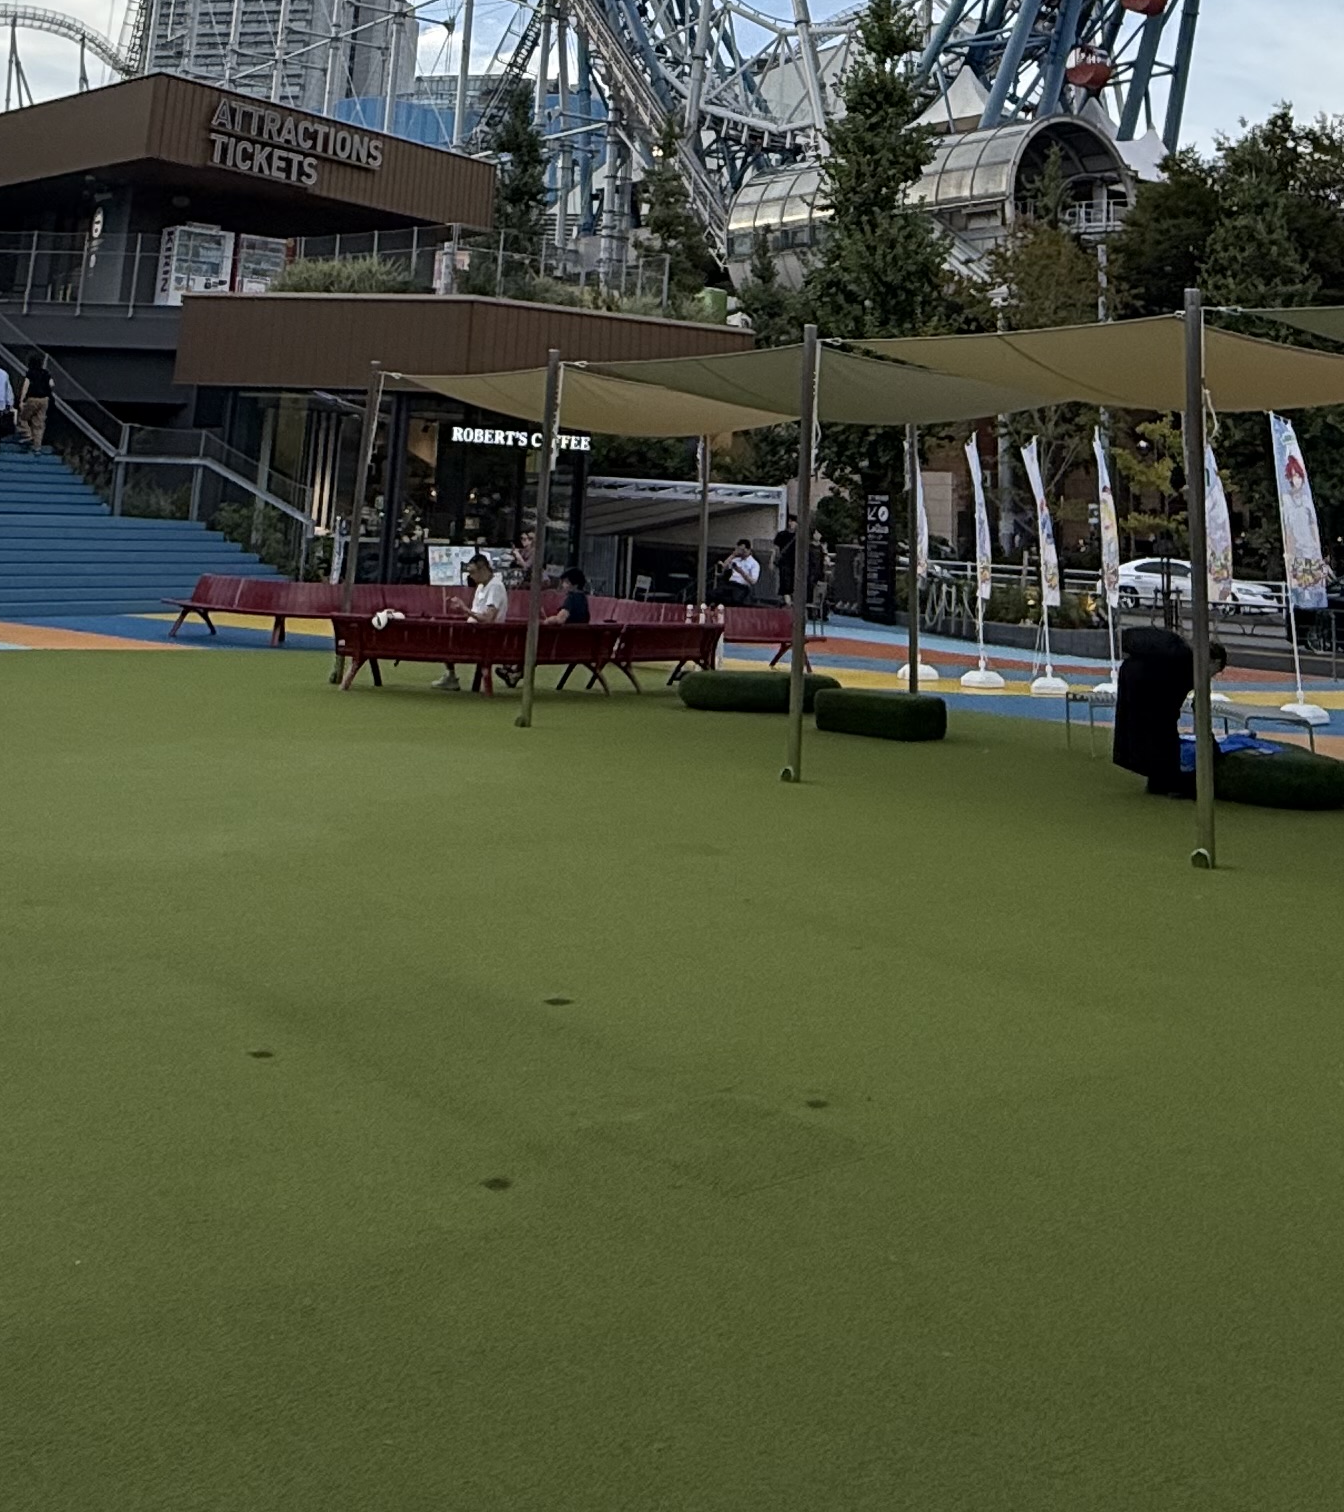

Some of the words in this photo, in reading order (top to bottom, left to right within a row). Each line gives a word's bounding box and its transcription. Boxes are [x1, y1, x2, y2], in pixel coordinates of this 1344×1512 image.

[210, 132, 318, 186] TICKETS
[211, 98, 383, 167] ATTRACTIONS
[451, 426, 528, 447] ROBERT'S
[530, 432, 591, 451] CFFEE
